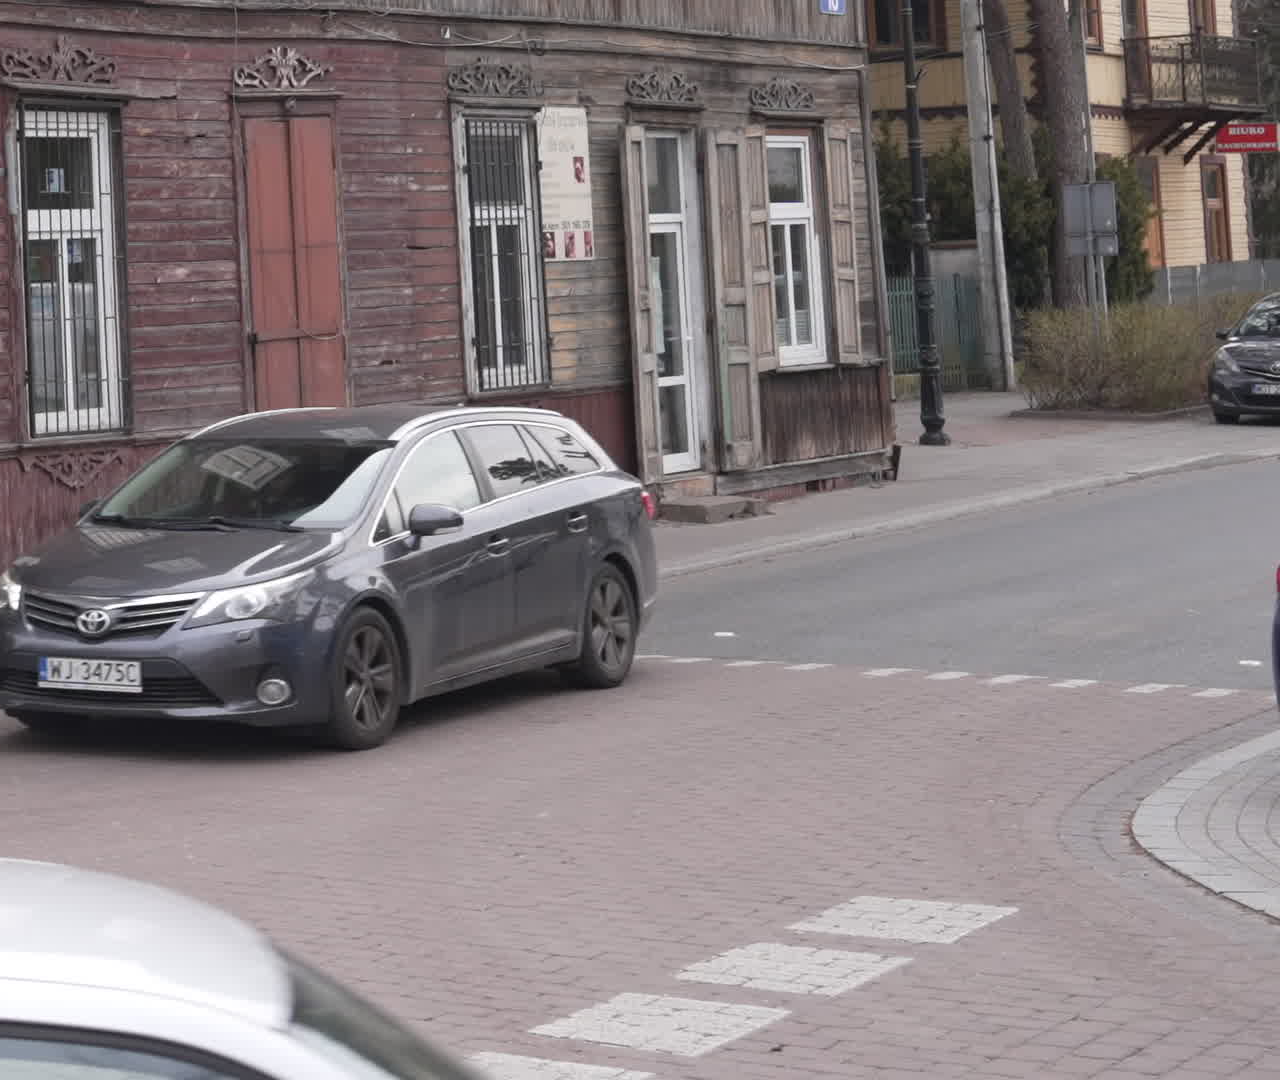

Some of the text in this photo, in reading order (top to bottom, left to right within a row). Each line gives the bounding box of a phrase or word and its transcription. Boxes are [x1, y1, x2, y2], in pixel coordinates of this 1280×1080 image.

[1228, 127, 1265, 136] BIURO
[49, 660, 137, 683] WJ 3475C
